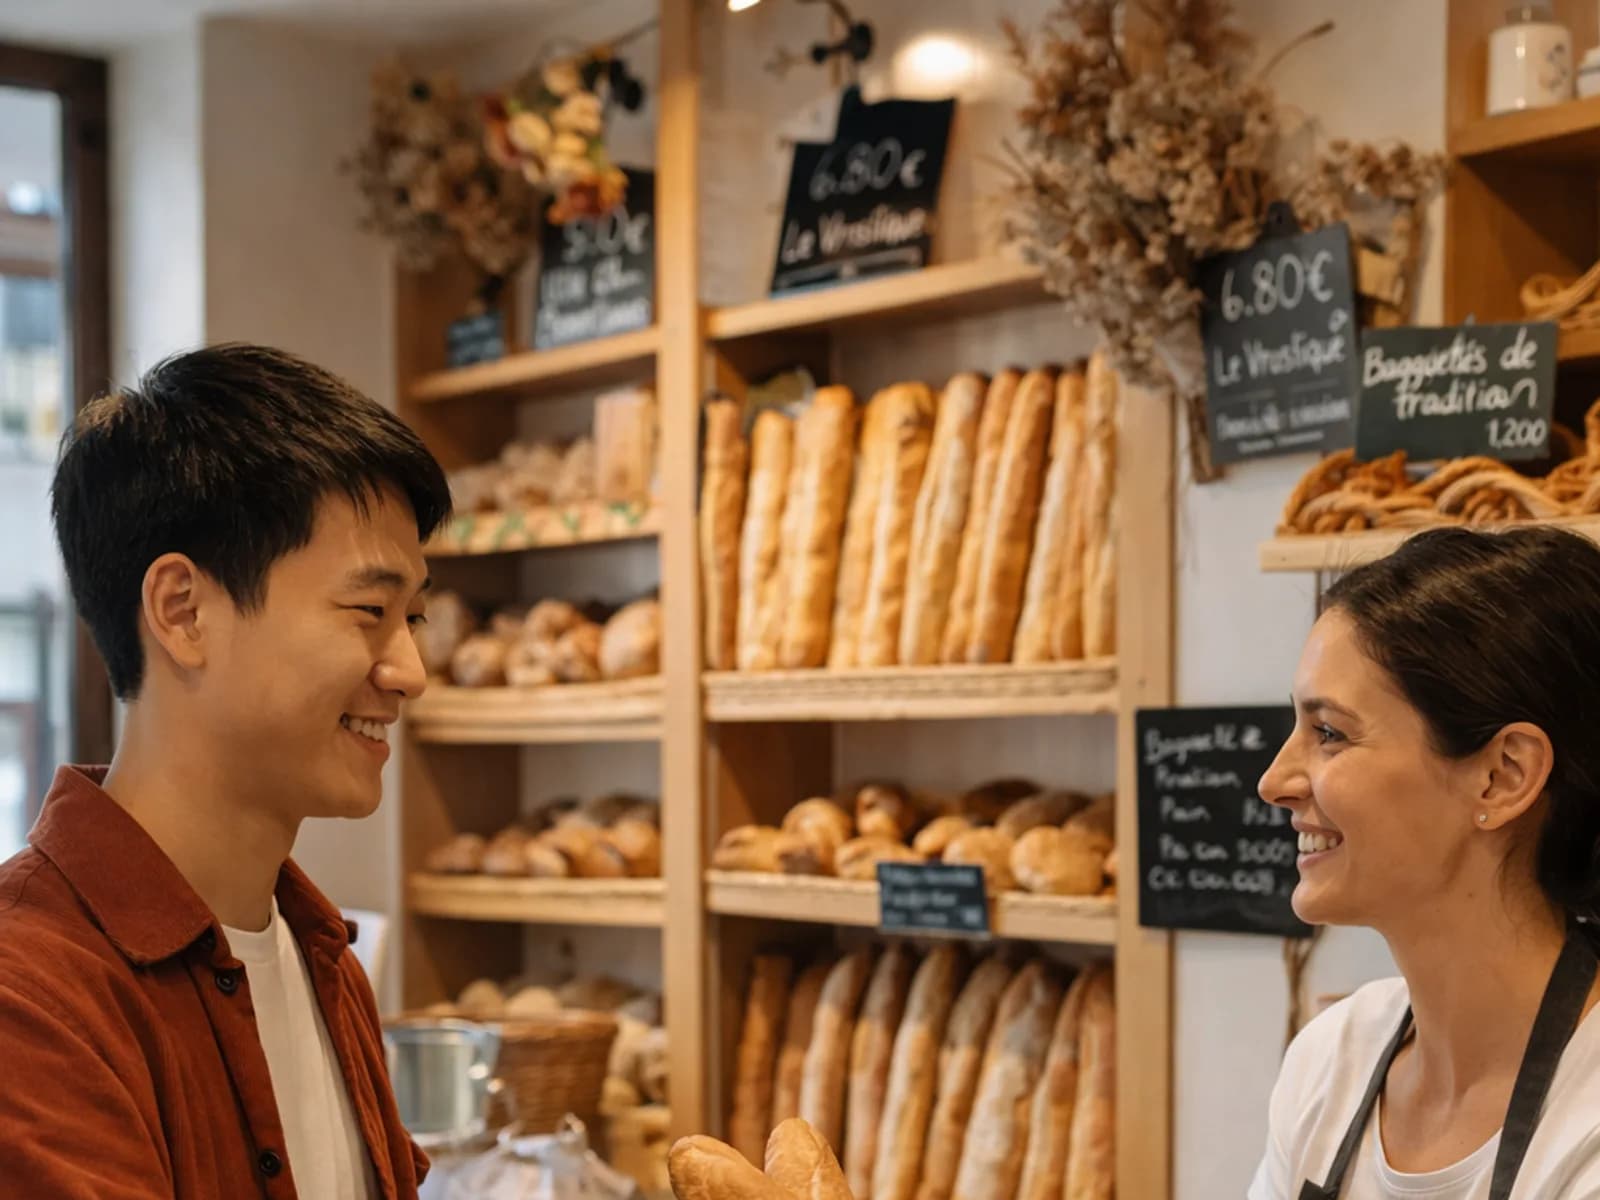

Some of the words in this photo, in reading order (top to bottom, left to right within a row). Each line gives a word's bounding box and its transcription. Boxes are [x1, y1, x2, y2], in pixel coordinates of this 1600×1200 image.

[1221, 249, 1334, 323] 6.80€
[1213, 346, 1241, 387] Le
[1499, 326, 1539, 370] de
